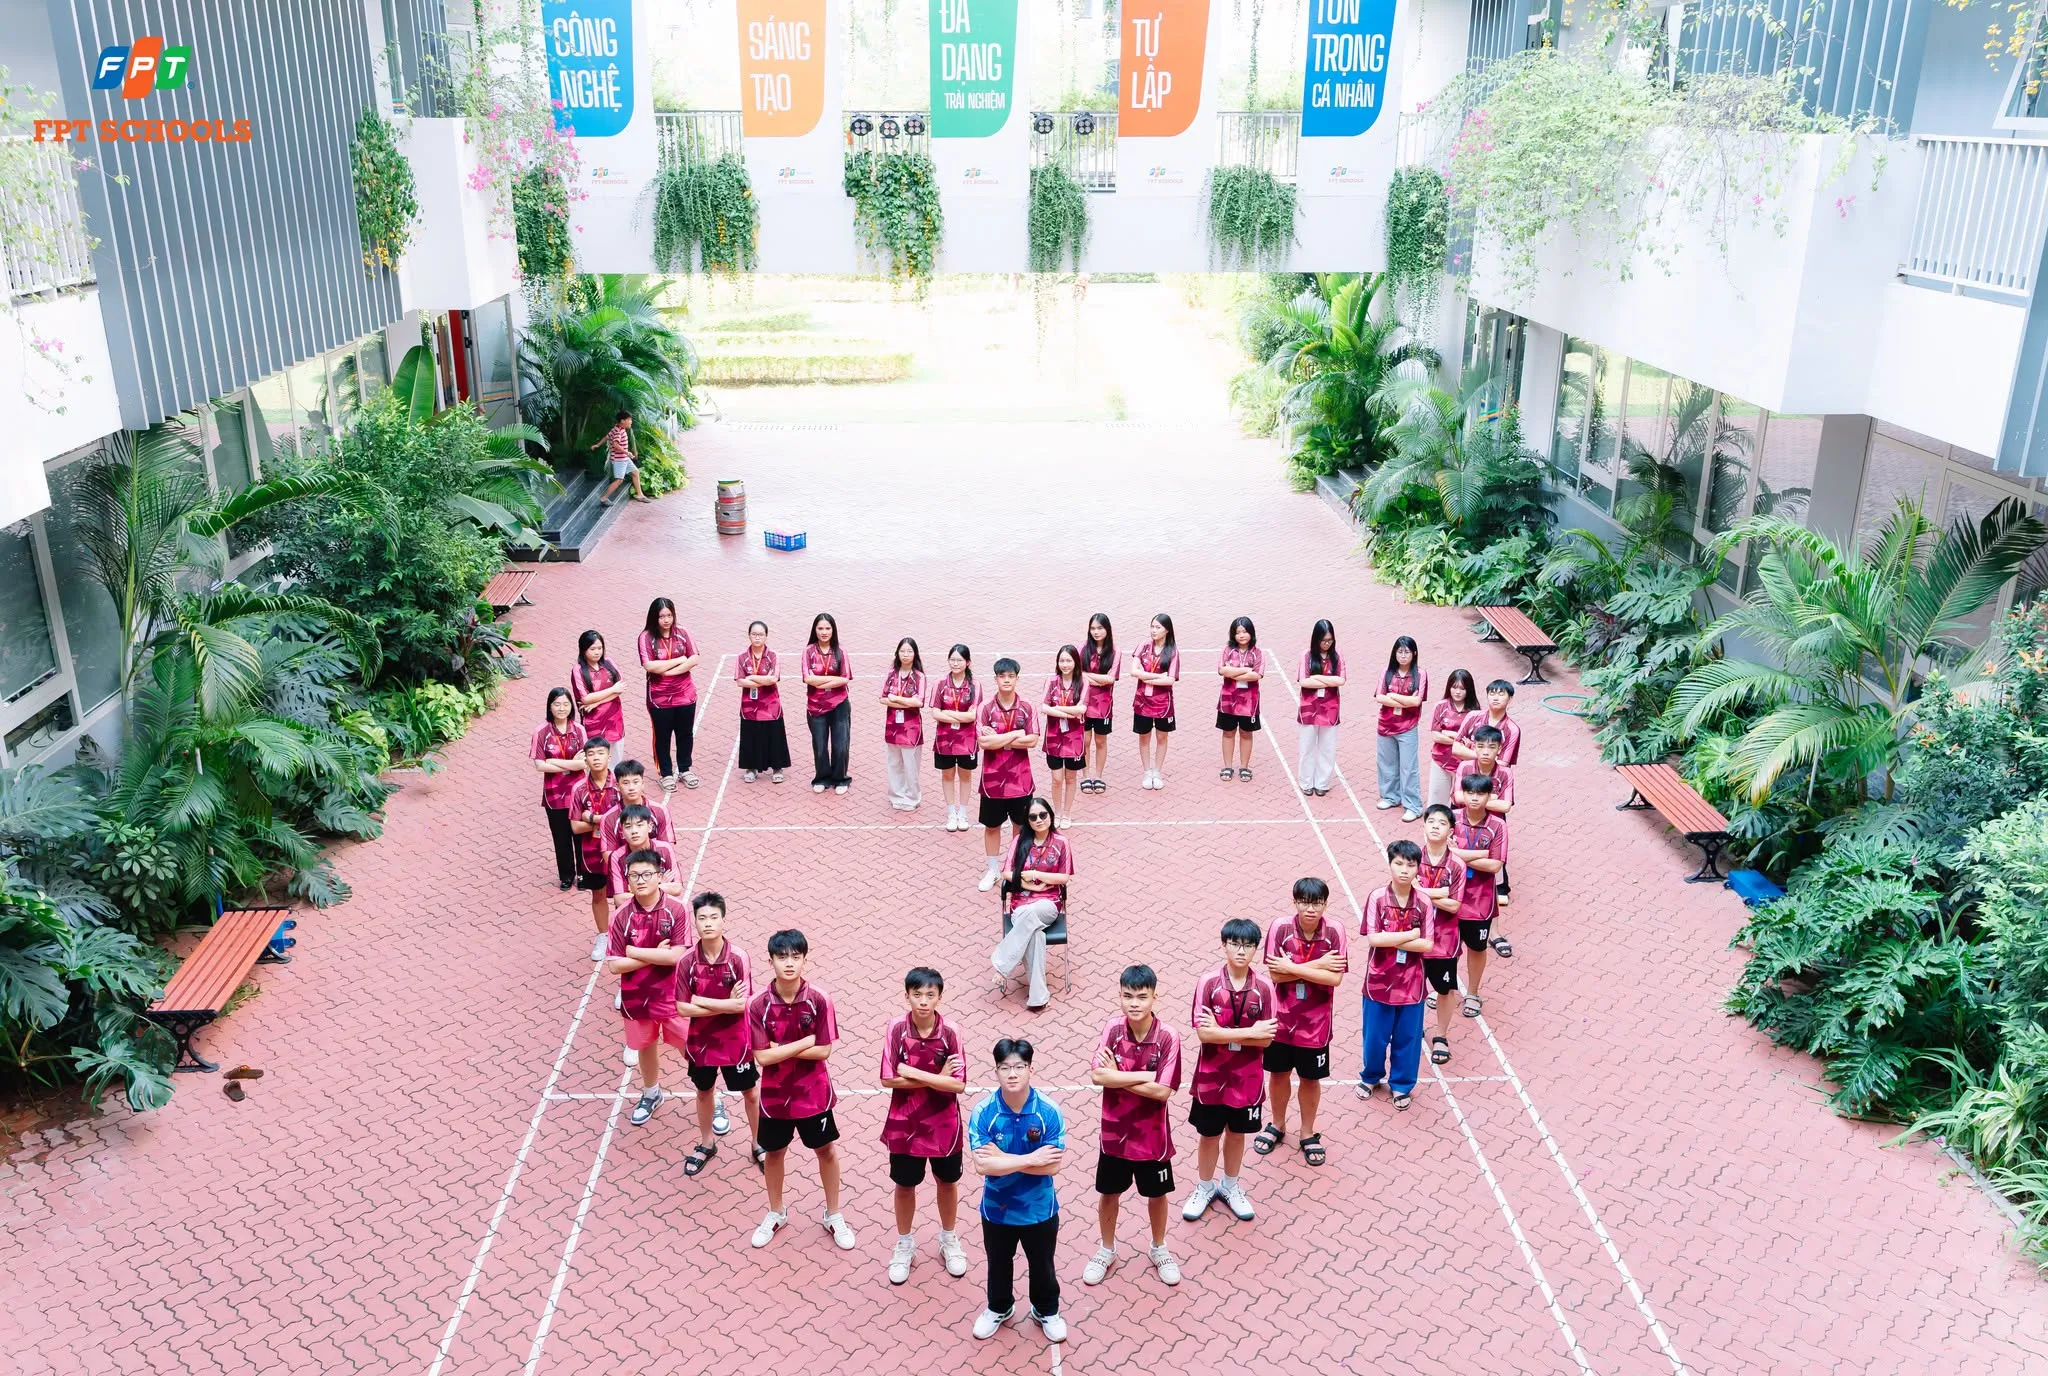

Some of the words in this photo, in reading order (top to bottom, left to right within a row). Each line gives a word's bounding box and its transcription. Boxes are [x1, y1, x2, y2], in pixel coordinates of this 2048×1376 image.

[553, 10, 618, 57] CÔNG
[939, 0, 971, 33] ĐA
[749, 15, 811, 61] SÁNG
[1132, 12, 1163, 62] TỰ
[1312, 34, 1385, 76] TRỌNG
[941, 43, 1002, 86] DẠNG
[560, 62, 622, 113] NGHỆ
[750, 73, 792, 116] TẠO
[967, 89, 1006, 111] NGHIỆM
[1131, 64, 1172, 113] LẬP
[1311, 79, 1331, 108] CÁ
[1334, 79, 1376, 108] NHÂN
[1479, 929, 1488, 941] 19
[1443, 970, 1450, 983] 4
[820, 1117, 828, 1132] 7
[1247, 1108, 1260, 1121] 14
[1158, 1168, 1168, 1183] 11
